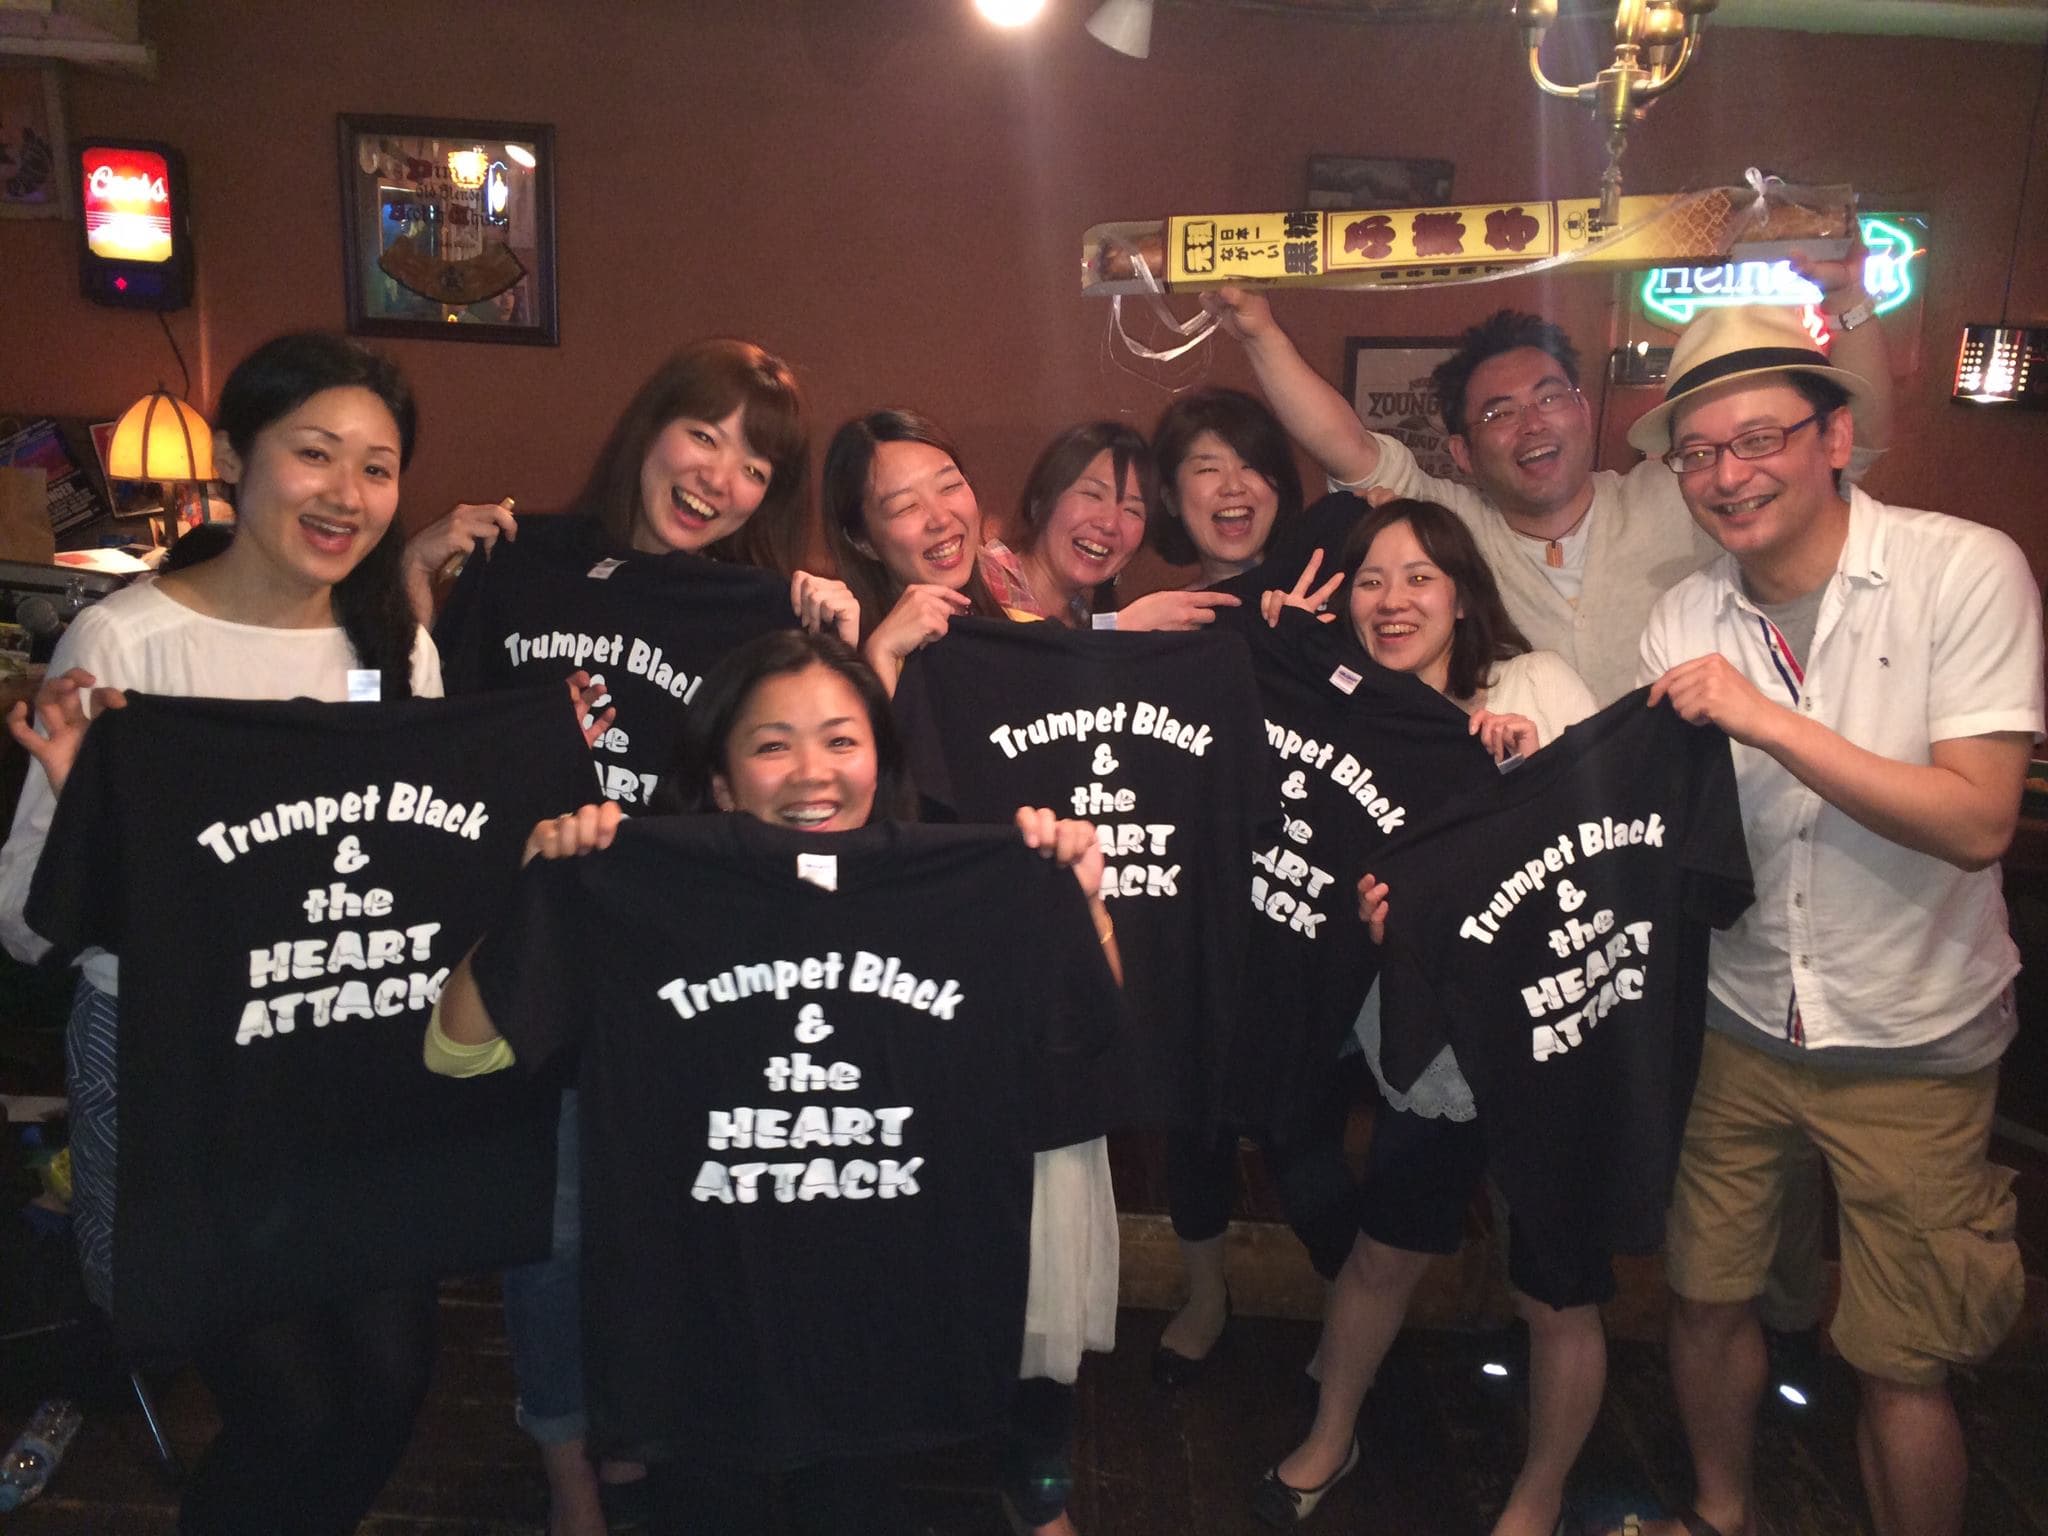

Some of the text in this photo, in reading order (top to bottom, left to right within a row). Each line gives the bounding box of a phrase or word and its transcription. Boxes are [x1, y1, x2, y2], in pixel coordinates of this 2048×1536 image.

[1221, 226, 1261, 241] 日本一
[1283, 212, 1319, 275] 黒糖
[504, 631, 623, 667] Trumpet
[989, 701, 1213, 759] Trumpet Black
[1092, 743, 1119, 775] &
[1264, 719, 1334, 769] mpet
[1331, 753, 1406, 835] Black
[1071, 782, 1136, 816] the
[1281, 770, 1308, 799] &
[197, 782, 489, 863] Trumpet Black
[1095, 824, 1176, 857] ART
[333, 835, 370, 874] &
[1252, 846, 1335, 898] ART
[1099, 864, 1181, 900] ACK
[1459, 813, 1666, 944] Trumpet Black
[1557, 879, 1587, 912] &
[303, 882, 394, 923] the
[250, 922, 441, 988] HEART
[1548, 909, 1614, 958] the
[657, 951, 964, 1020] Trumpet Black
[1521, 921, 1653, 1017] HEART
[235, 967, 450, 1045] ATTACK
[794, 1003, 834, 1043] &
[1533, 965, 1647, 1062] ATTAC
[764, 1053, 861, 1092] the
[708, 1106, 913, 1150] HEART
[691, 1157, 924, 1204] ATTACK
